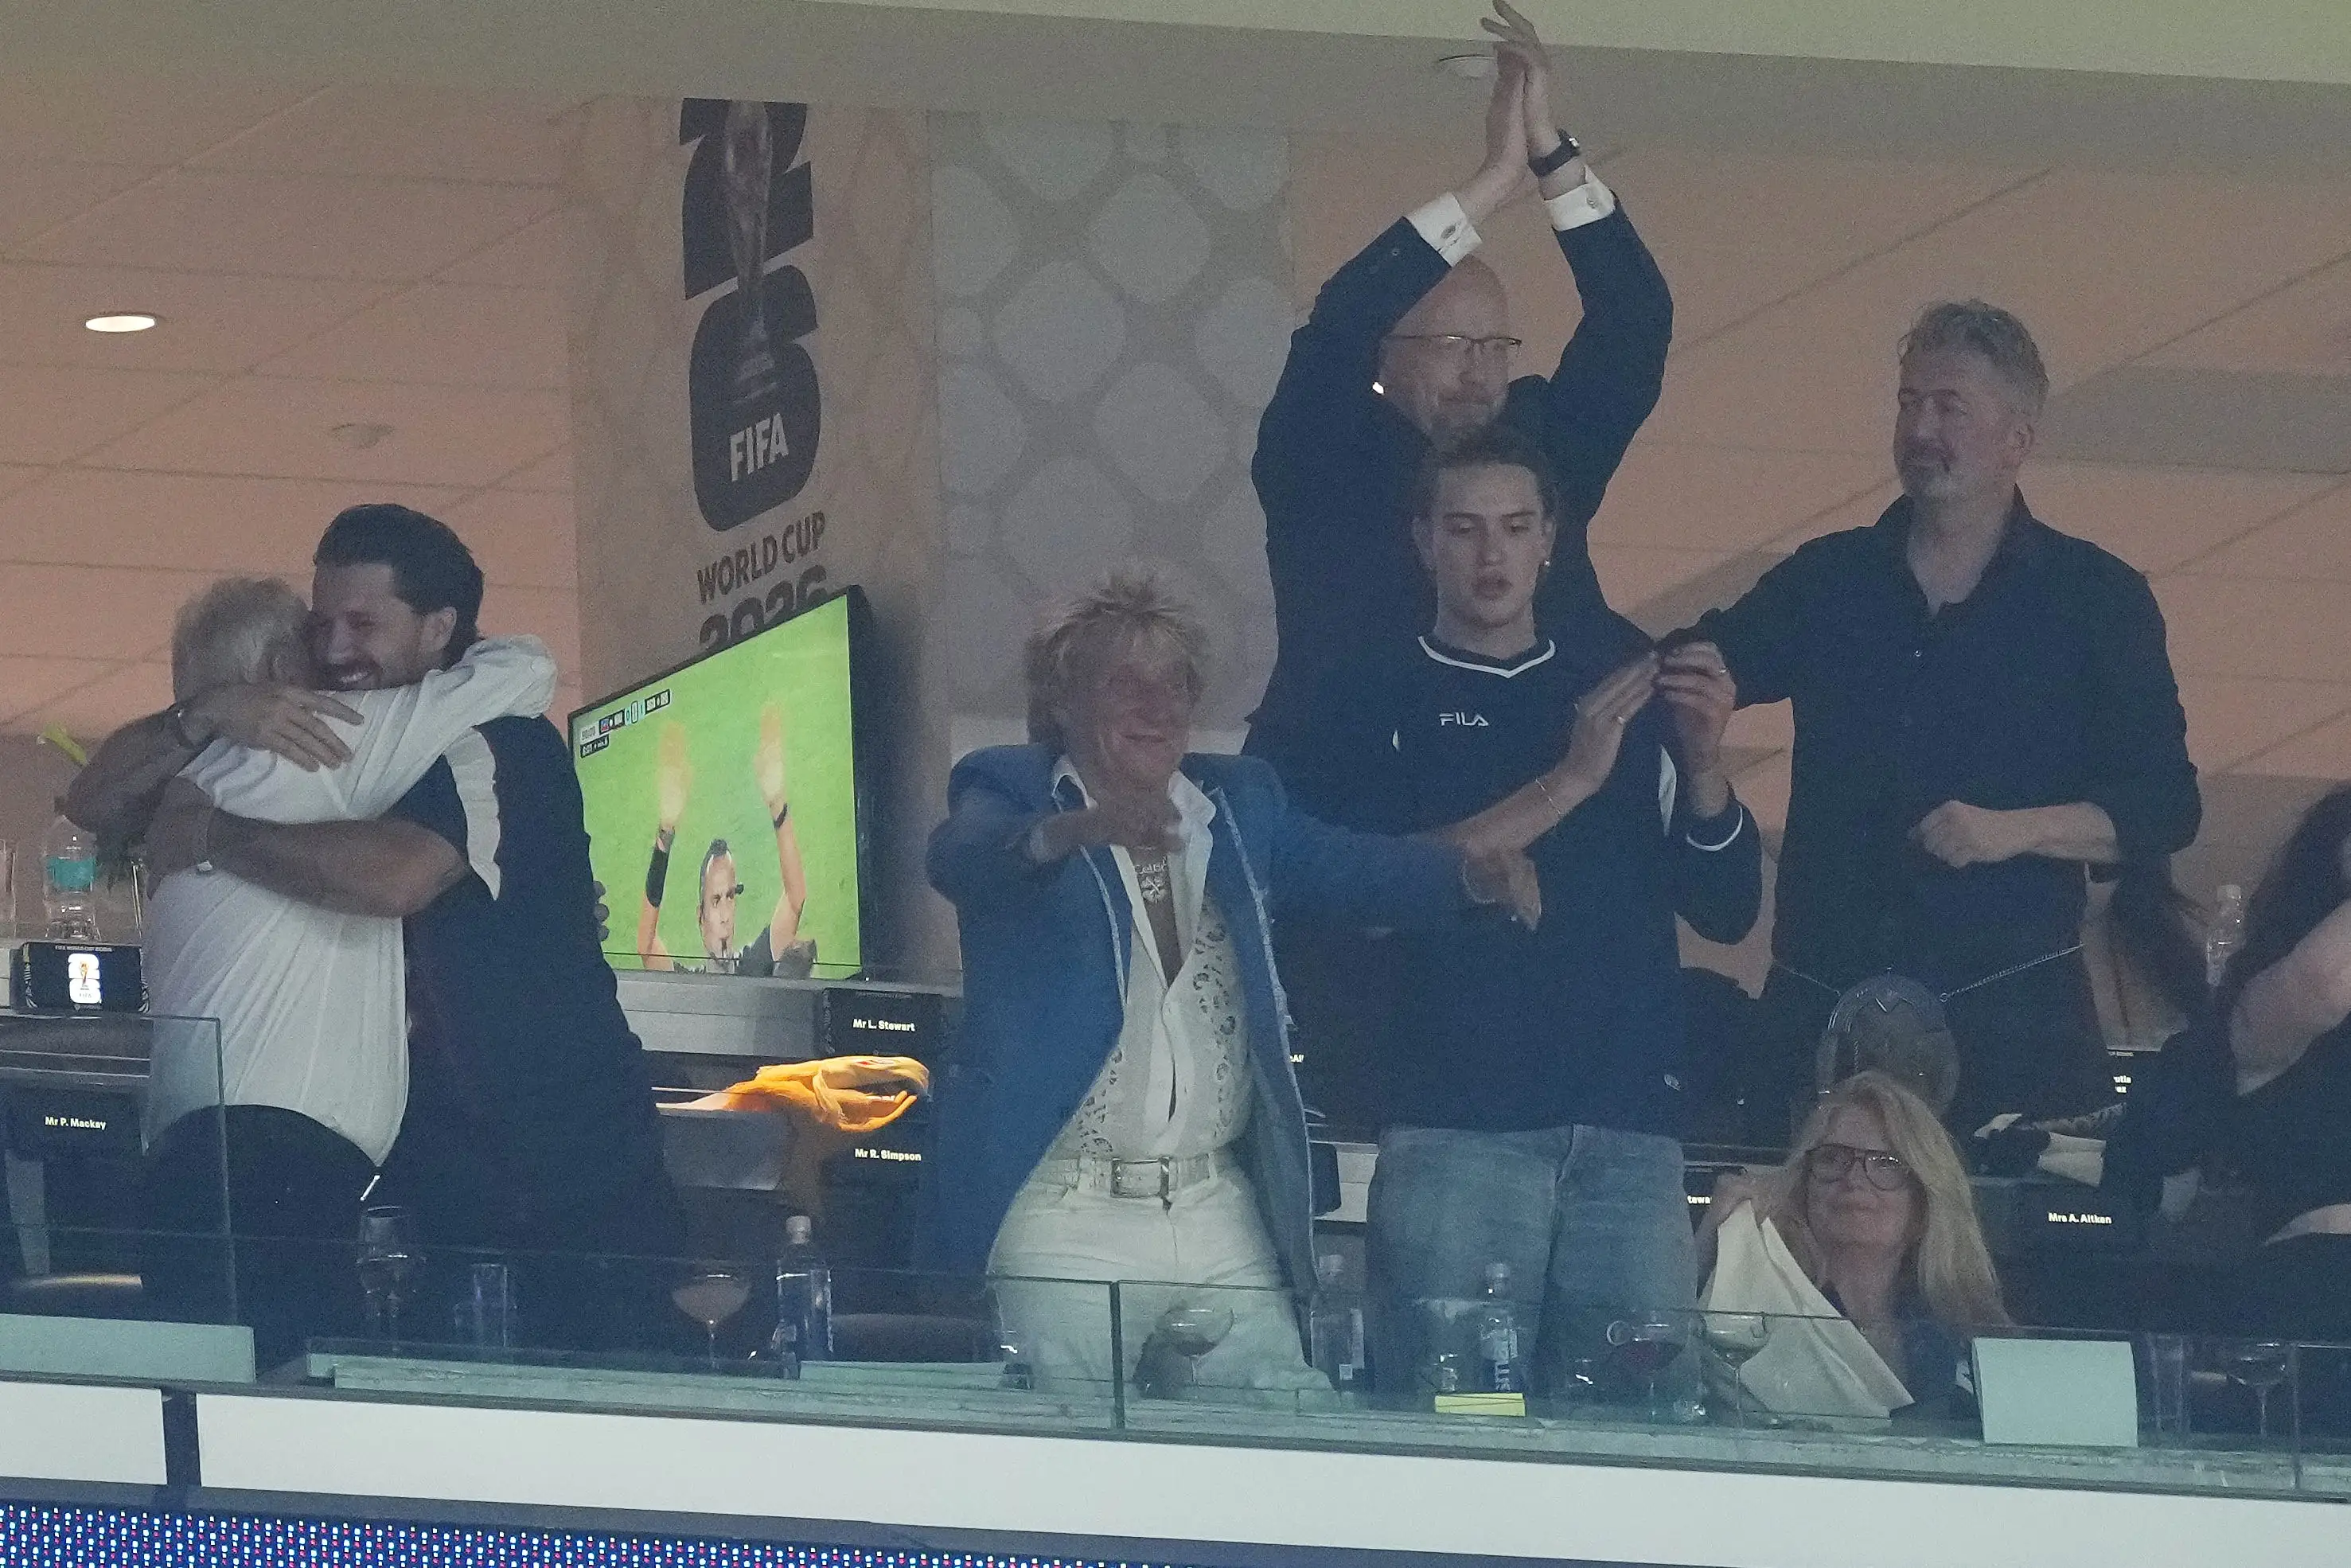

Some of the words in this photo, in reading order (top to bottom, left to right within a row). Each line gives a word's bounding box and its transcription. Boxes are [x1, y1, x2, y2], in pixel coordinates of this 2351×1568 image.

[730, 412, 789, 482] FIFA
[697, 534, 778, 605] WORLD
[782, 509, 825, 564] CUP
[1439, 712, 1489, 726] FILA
[853, 1019, 866, 1028] Mr
[868, 1020, 876, 1028] L.
[879, 1020, 915, 1032] Stewart
[45, 1117, 58, 1125] Mr
[60, 1117, 68, 1126] P.
[71, 1118, 106, 1130] Mackay
[855, 1149, 868, 1158] Mr
[870, 1149, 879, 1159] R.
[881, 1150, 922, 1161] Simpson
[2049, 1213, 2067, 1222] Mrs
[2069, 1214, 2079, 1223] A.
[2080, 1214, 2111, 1224] Aitken
